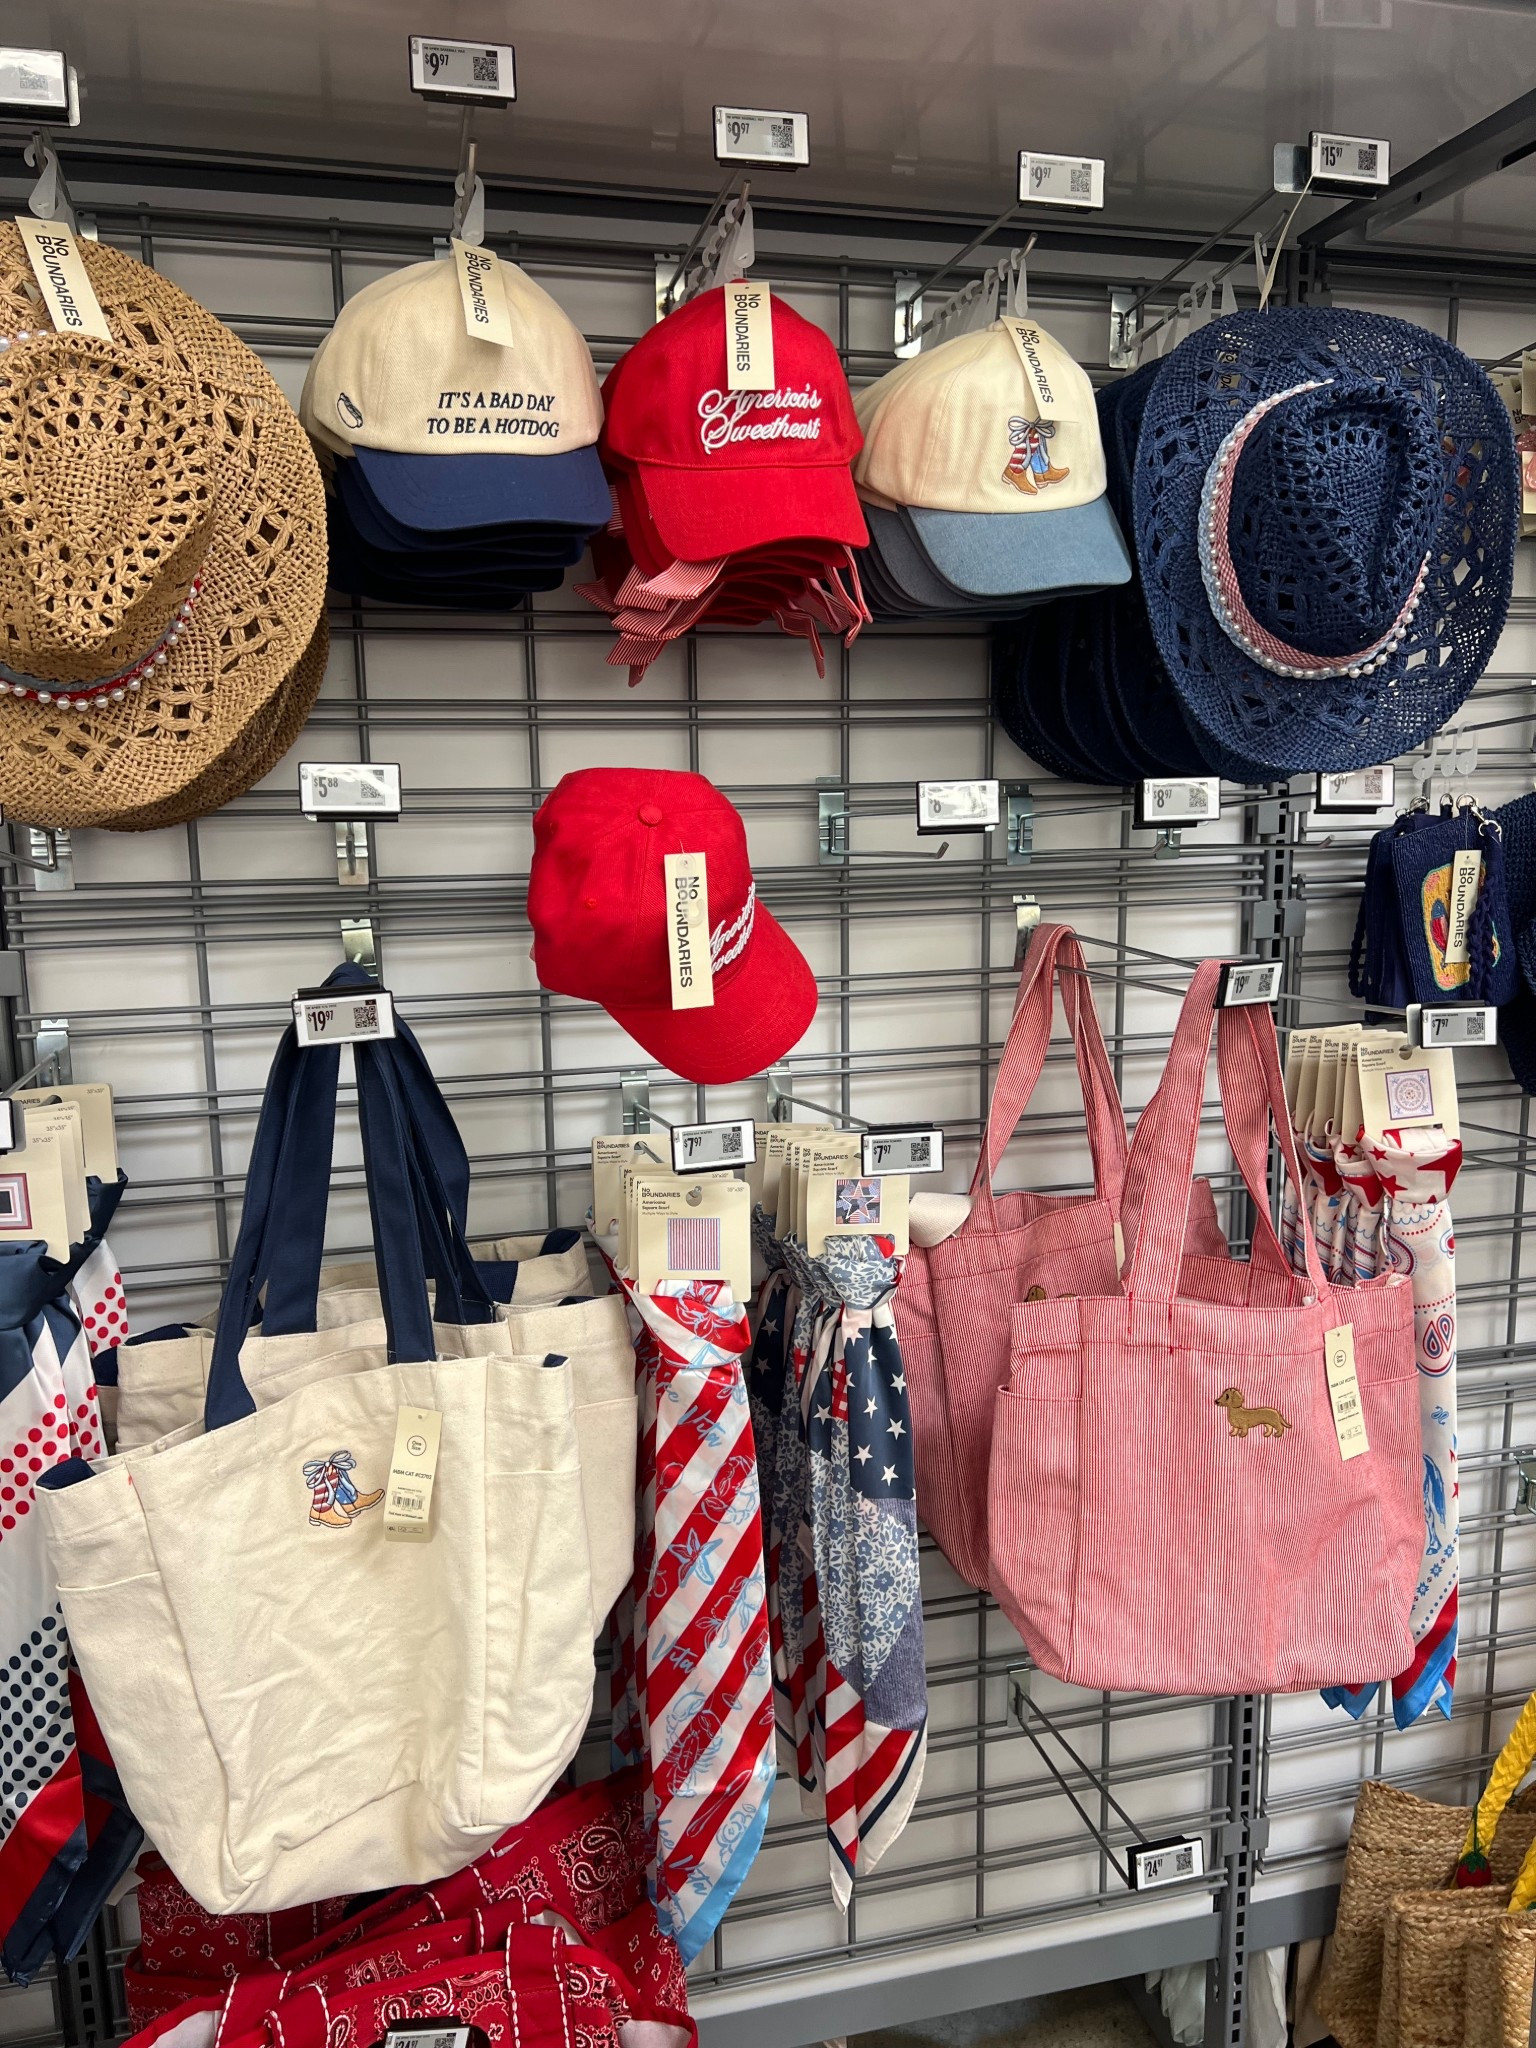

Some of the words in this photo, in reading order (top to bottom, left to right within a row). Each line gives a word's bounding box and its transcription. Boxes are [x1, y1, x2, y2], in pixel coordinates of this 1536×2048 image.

[35, 234, 82, 326] BOUNDARIES
[464, 252, 489, 324] BOUNDARIES
[734, 294, 750, 372] BOUNDARIES
[1016, 327, 1054, 402] BOUNDARIES
[427, 418, 450, 434] TO
[453, 418, 476, 434] BE
[479, 417, 492, 434] A
[494, 418, 560, 438] HOTDOG
[438, 392, 470, 409] IT'S
[474, 392, 486, 408] A
[490, 392, 524, 410] BAD
[527, 394, 556, 412] DAY
[700, 412, 820, 454] Sweetheart
[675, 878, 692, 988] BOUNDARIES
[1454, 868, 1468, 948] BOUNDARIES
